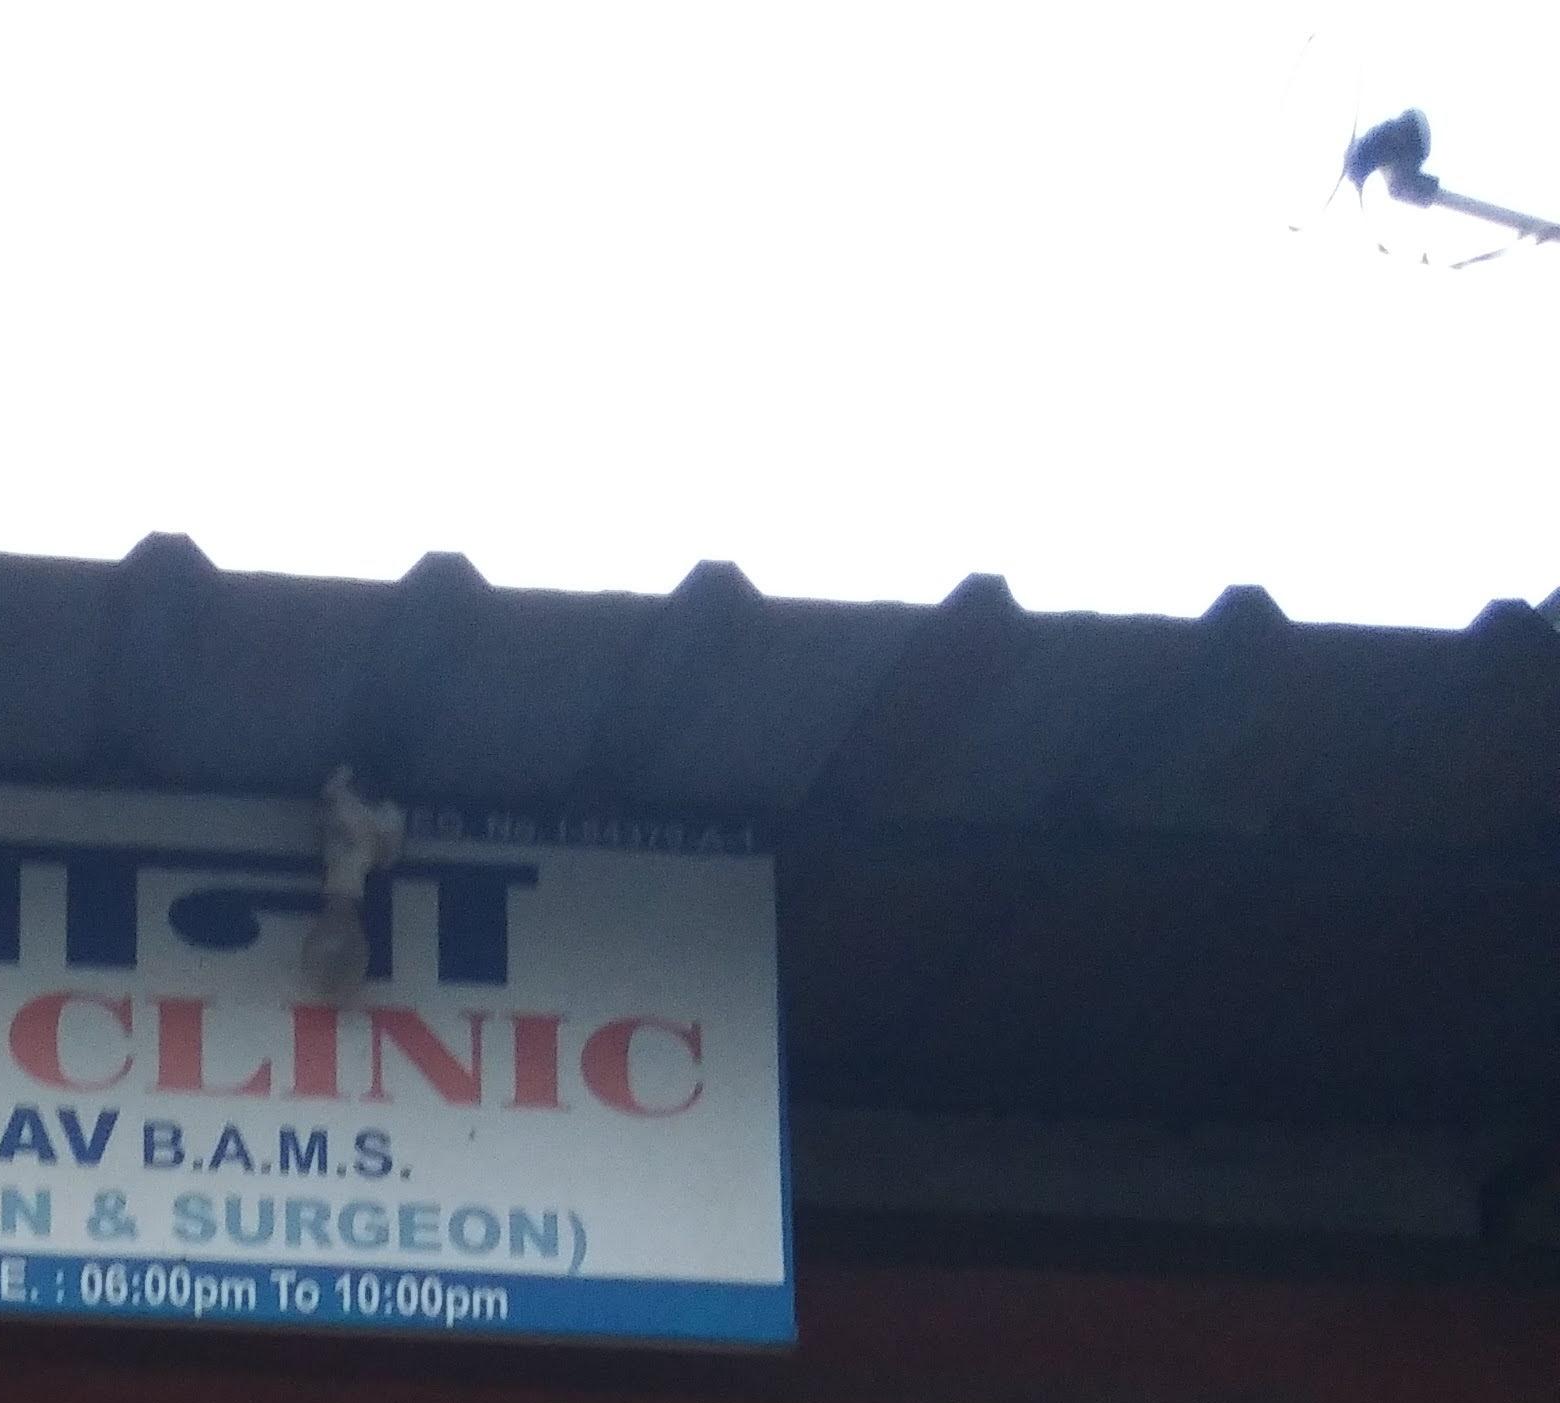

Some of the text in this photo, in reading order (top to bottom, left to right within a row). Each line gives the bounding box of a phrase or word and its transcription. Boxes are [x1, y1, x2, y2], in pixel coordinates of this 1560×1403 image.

[8, 988, 706, 1118] CLINIC
[141, 1118, 414, 1181] B.A.M.S.
[85, 1188, 139, 1243] &
[171, 1191, 589, 1277] SURGEON)
[78, 1260, 258, 1319] 06:00pm
[269, 1268, 320, 1314] To
[333, 1273, 510, 1328] 10:00pm
